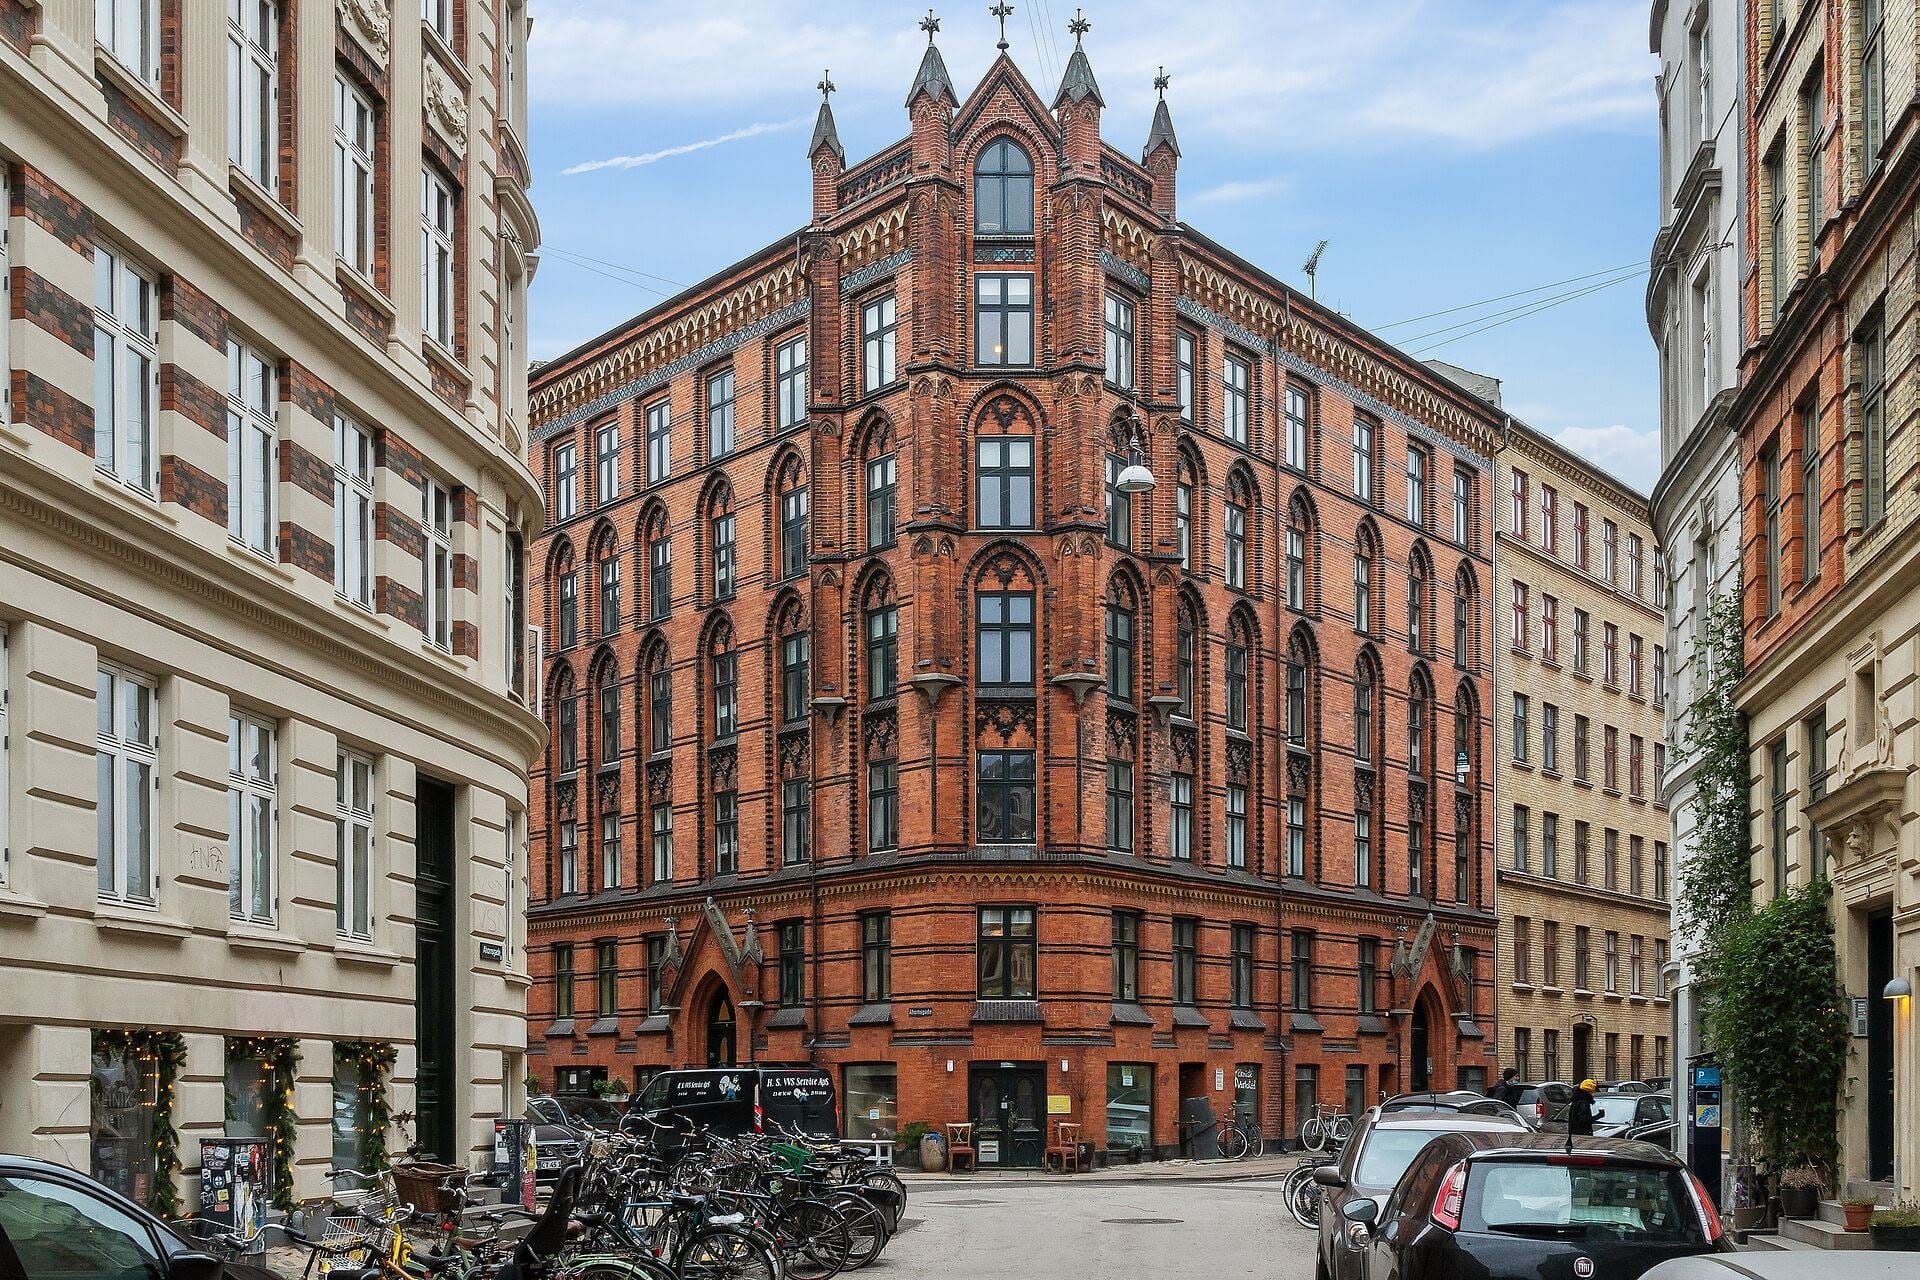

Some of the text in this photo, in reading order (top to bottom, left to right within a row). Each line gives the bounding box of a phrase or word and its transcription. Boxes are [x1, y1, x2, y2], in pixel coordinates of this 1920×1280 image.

[1698, 1071, 1705, 1079] P
[783, 1077, 795, 1086] VVS
[796, 1077, 817, 1086] Service
[818, 1077, 829, 1087] ApS
